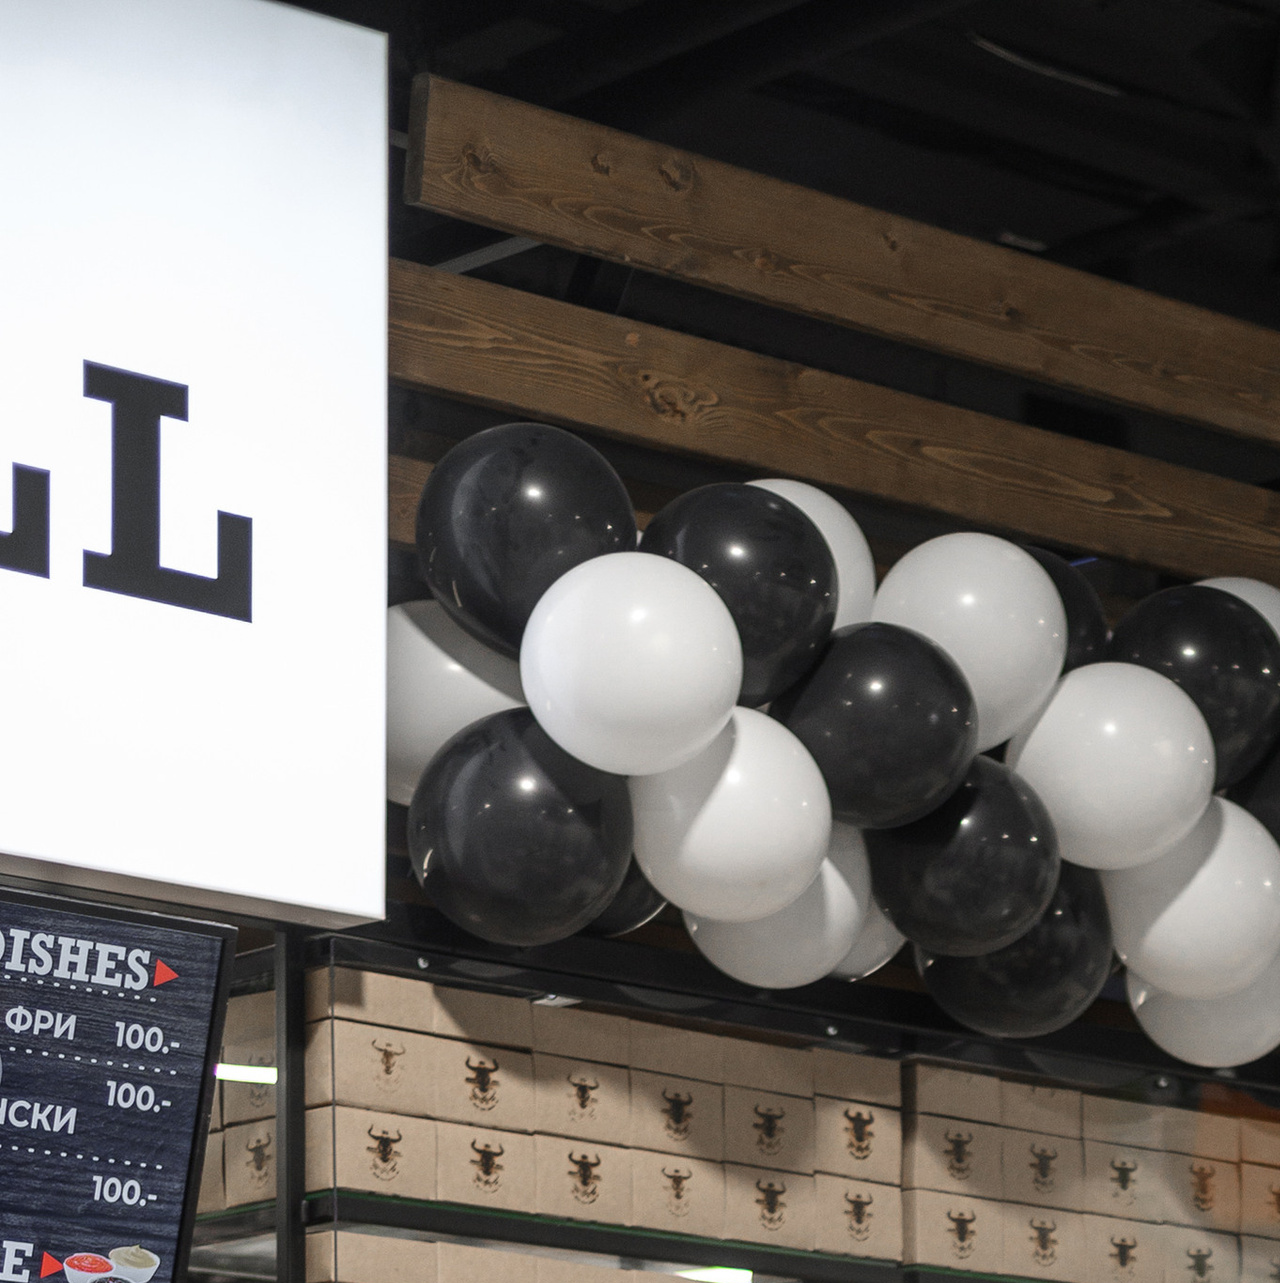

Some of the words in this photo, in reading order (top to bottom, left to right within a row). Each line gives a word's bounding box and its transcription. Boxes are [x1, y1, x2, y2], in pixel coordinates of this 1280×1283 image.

[0, 928, 151, 991] ISHES
[5, 1005, 77, 1040] ФРИ
[115, 1020, 181, 1054] 100.-
[106, 1080, 172, 1113] 100.-
[92, 1175, 158, 1207] 100.-
